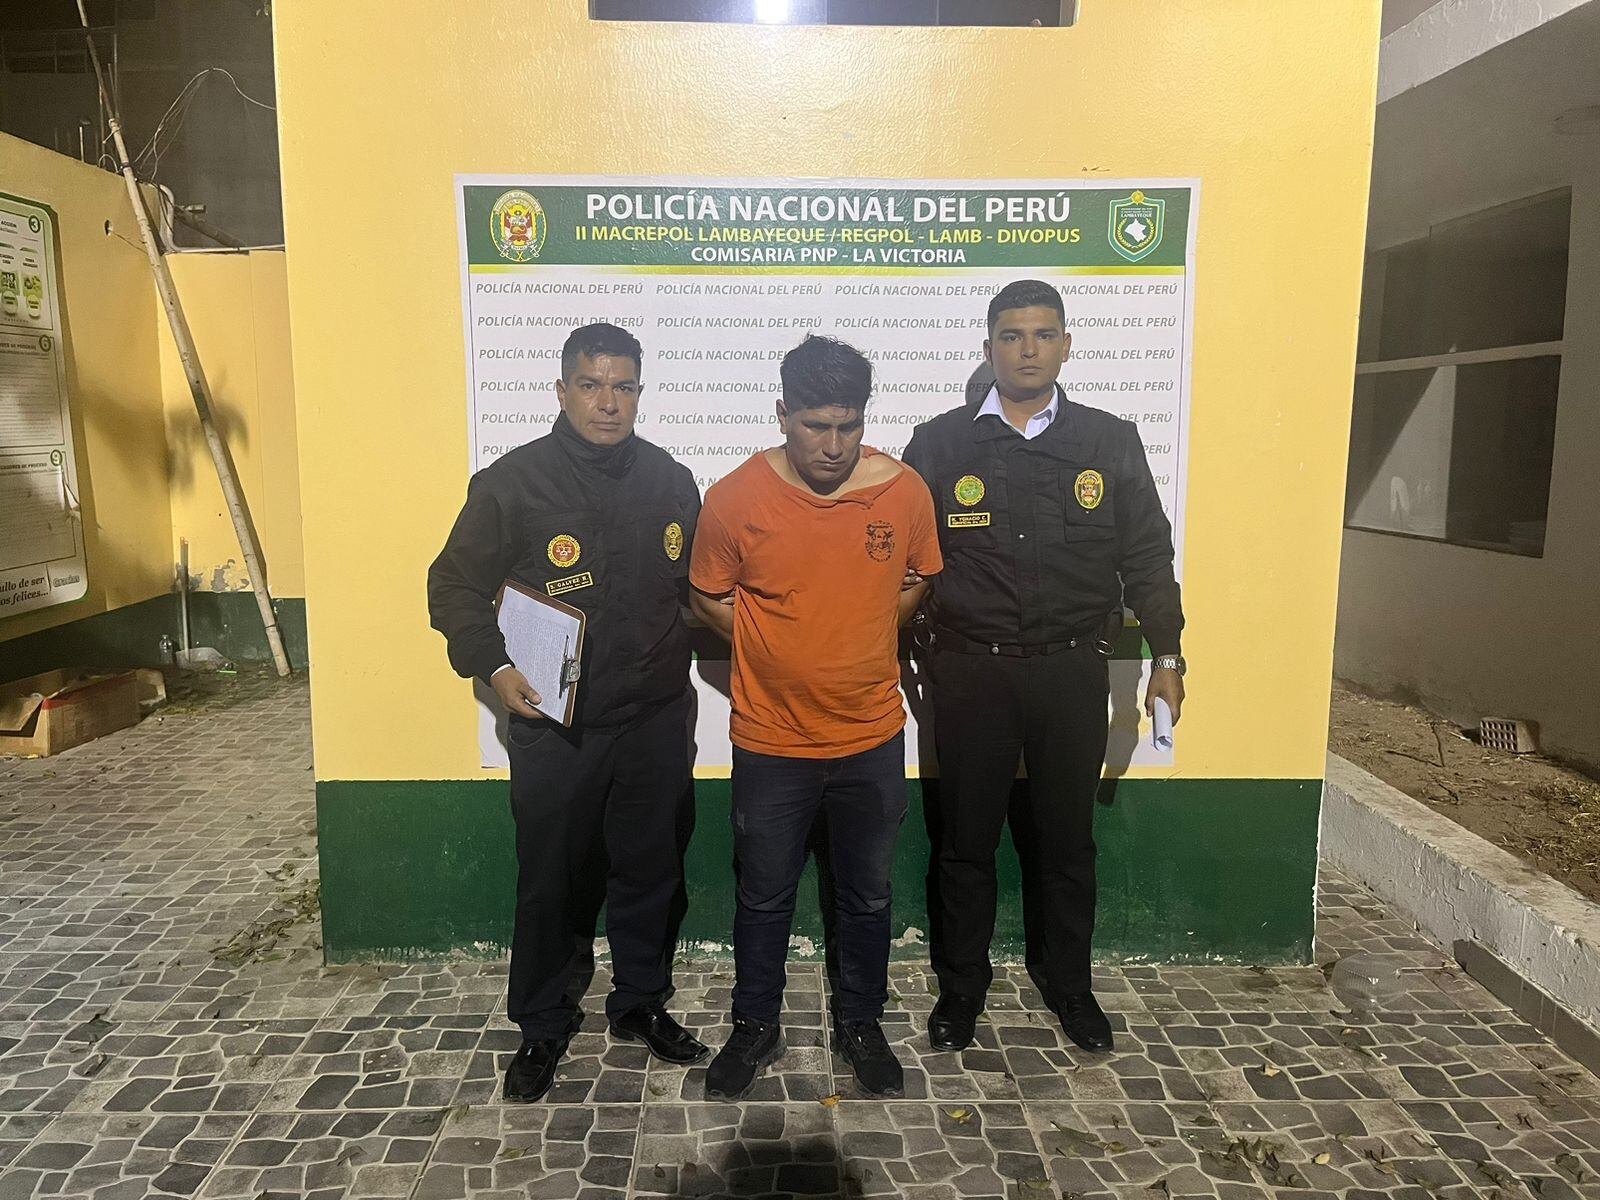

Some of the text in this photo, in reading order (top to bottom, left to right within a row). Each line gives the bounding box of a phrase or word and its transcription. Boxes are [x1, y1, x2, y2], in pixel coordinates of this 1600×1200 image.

[587, 190, 1070, 223] POLICÍA NACIONAL DEL PERÚ
[576, 226, 587, 241] II
[592, 226, 694, 242] MACREPOL
[699, 227, 825, 243] LAMBAYEQUE
[841, 228, 914, 243] REGPOL
[930, 229, 982, 243] LAMB
[998, 229, 1081, 243] DIVOPUS
[691, 247, 795, 262] COMISARIA
[801, 247, 838, 262] PNP
[853, 248, 876, 262] LA
[880, 248, 966, 263] VICTORIA
[476, 282, 644, 294] POLICÍA NACIONAL DEL PERÚ
[656, 283, 822, 294] POLICÍA NACIONAL DEL PERÚ
[835, 284, 1000, 296] POLICÍA NACIONAL DEL PERÚ
[1060, 285, 1120, 295] NACIONAL
[1123, 285, 1144, 295] DEL
[1147, 282, 1178, 295] PERÚ
[478, 315, 523, 326] POLICÍA
[614, 316, 644, 327] PERÚ
[657, 316, 822, 328] POLICÍA NACIONAL DEL PERÚ
[834, 317, 880, 328] POLICÍA
[882, 318, 942, 328] NACIONAL
[944, 318, 966, 328] DEL
[1122, 317, 1143, 327] DEL
[1146, 315, 1176, 327] PERÚ
[479, 348, 562, 359] POLICÍA NACIO
[658, 348, 702, 360] POLICÍA
[706, 350, 765, 360] NACIONAL
[882, 351, 941, 360] NACIONAL
[944, 351, 965, 360] DEL
[968, 351, 983, 360] PE
[1068, 348, 1175, 360] ACIONAL DEL PERÚ
[480, 380, 556, 392] POLICÍA NACI
[658, 381, 783, 392] POLICÍA NACIONAL DE
[882, 384, 940, 393] NACIONAL
[943, 384, 964, 393] DEL
[968, 383, 988, 392] PER
[1120, 382, 1141, 391] DEL
[1144, 380, 1174, 391] PERÚ
[482, 412, 527, 424] POLICÍA
[659, 413, 702, 424] POLICÍA
[706, 415, 765, 424] NACIONAL
[1142, 411, 1172, 423] PERÚ
[1155, 474, 1169, 485] RÚ
[0, 577, 44, 592] ullo de ser
[0, 597, 10, 606] os
